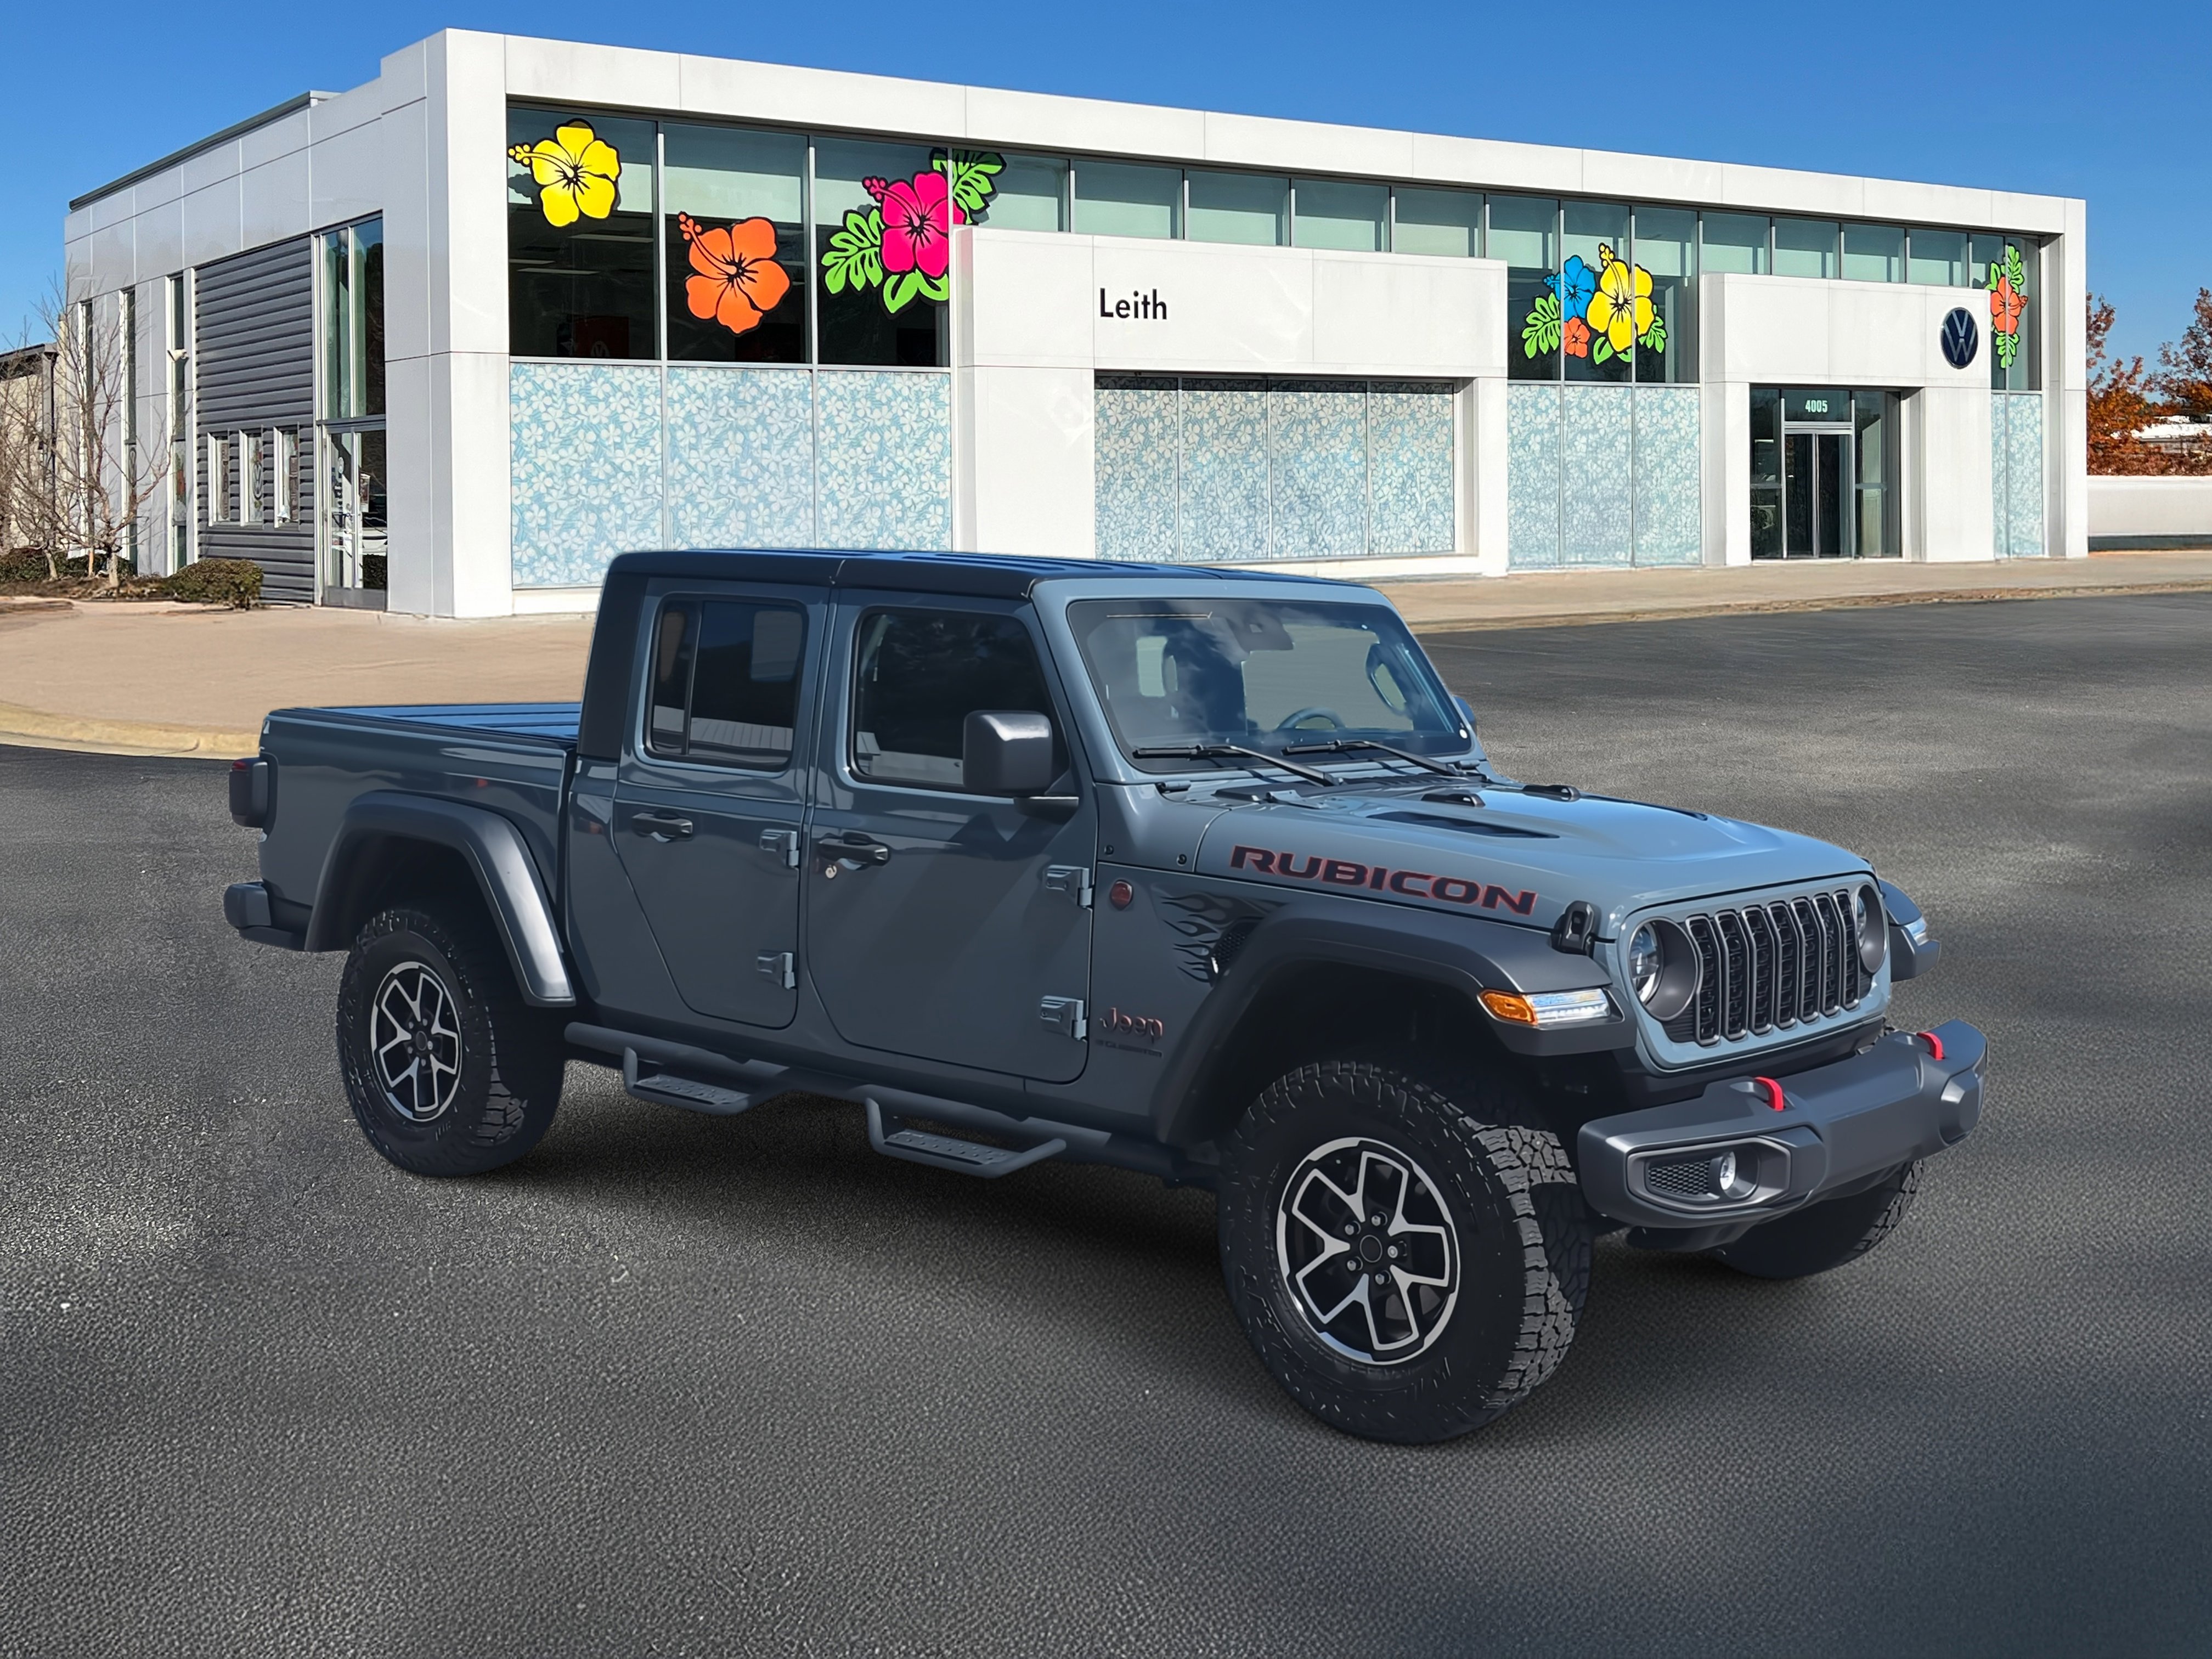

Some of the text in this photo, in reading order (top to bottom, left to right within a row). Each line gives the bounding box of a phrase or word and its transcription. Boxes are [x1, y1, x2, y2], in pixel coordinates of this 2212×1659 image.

[1100, 287, 1167, 320] Leith
[1805, 399, 1828, 413] 4005
[1230, 844, 1538, 916] RUBICON
[1099, 1007, 1163, 1044] Jeep
